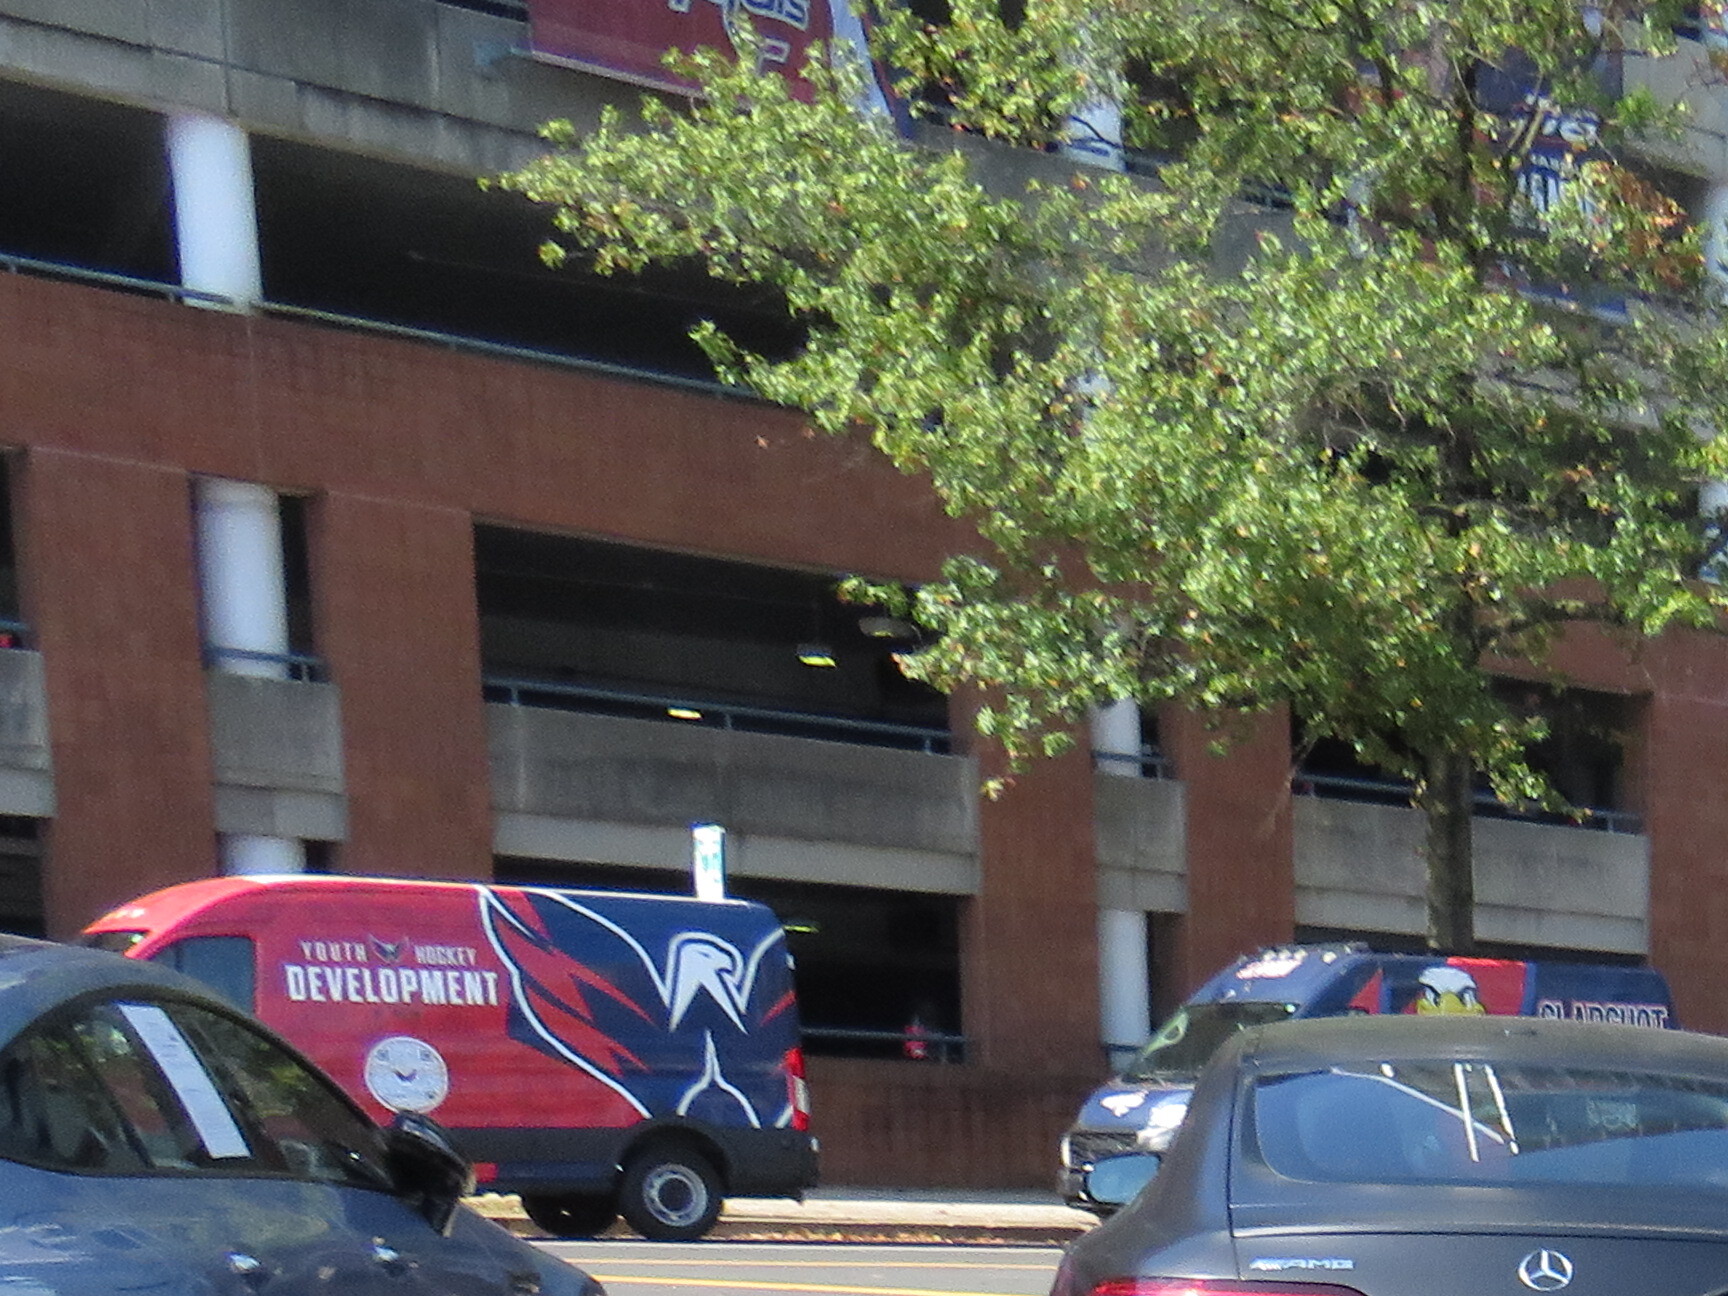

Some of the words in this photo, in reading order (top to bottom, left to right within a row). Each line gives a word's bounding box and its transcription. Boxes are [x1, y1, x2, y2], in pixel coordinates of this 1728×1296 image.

[301, 939, 368, 963] YOUTH
[413, 944, 477, 967] HOCKEY
[284, 963, 499, 1006] DEVELOPMENT
